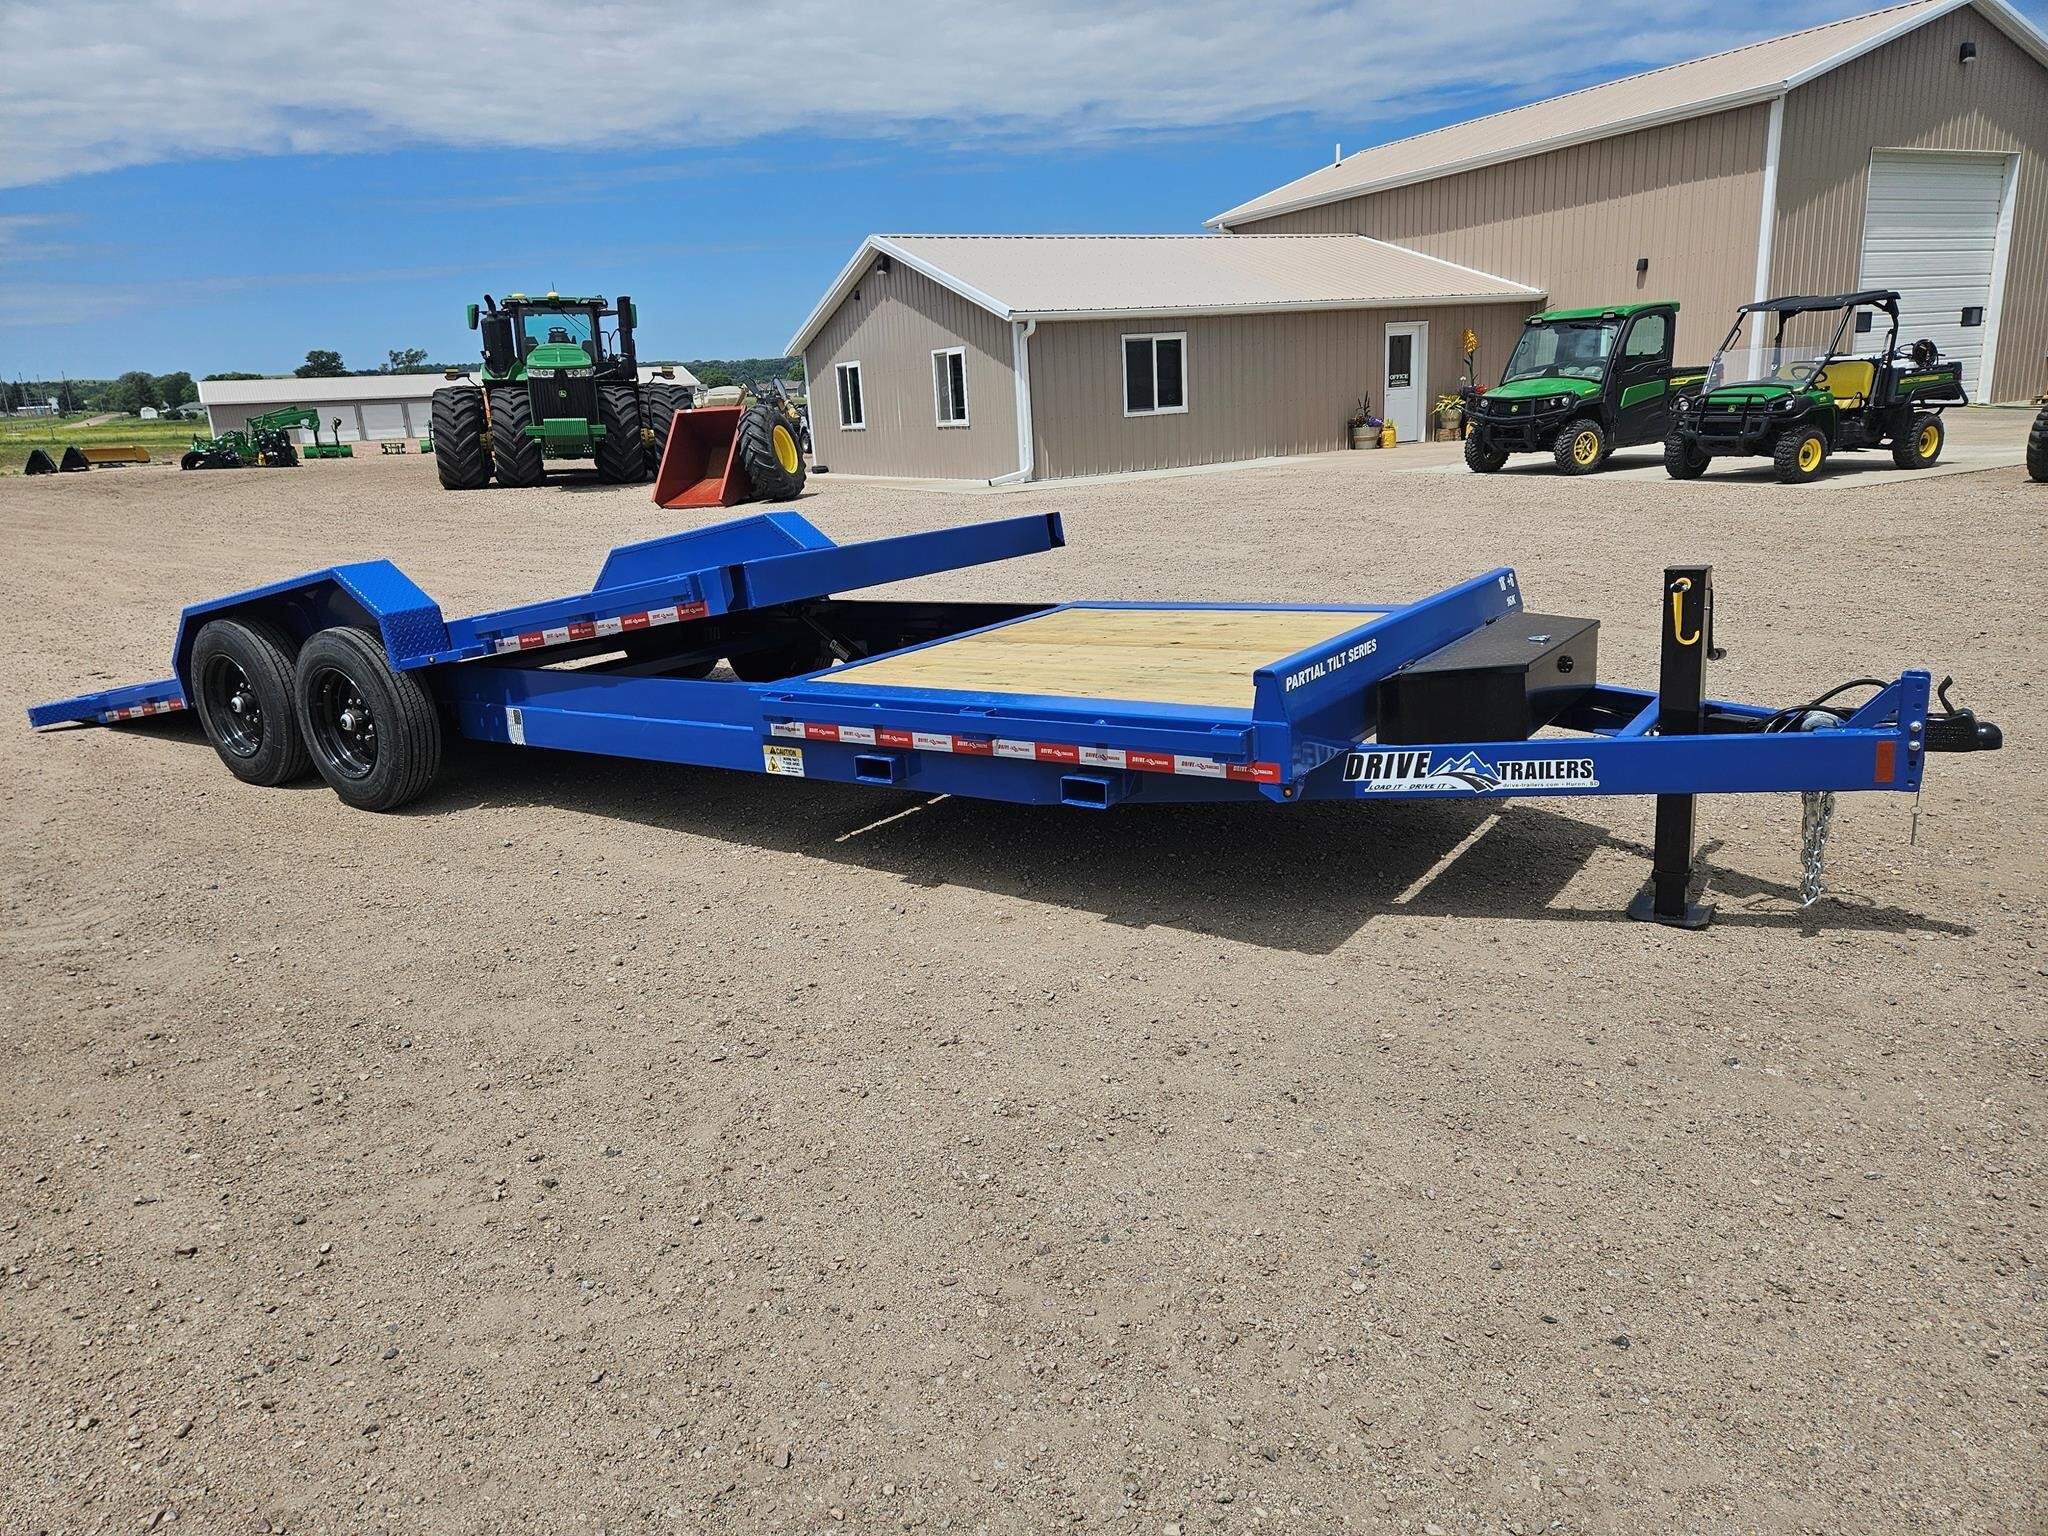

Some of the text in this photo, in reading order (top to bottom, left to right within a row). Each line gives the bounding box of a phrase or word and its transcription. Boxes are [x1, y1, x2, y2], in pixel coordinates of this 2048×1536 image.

[1286, 638, 1377, 692] PARTIAL TILT SERIES
[1344, 753, 1592, 780] DRIVE TRAILERS
